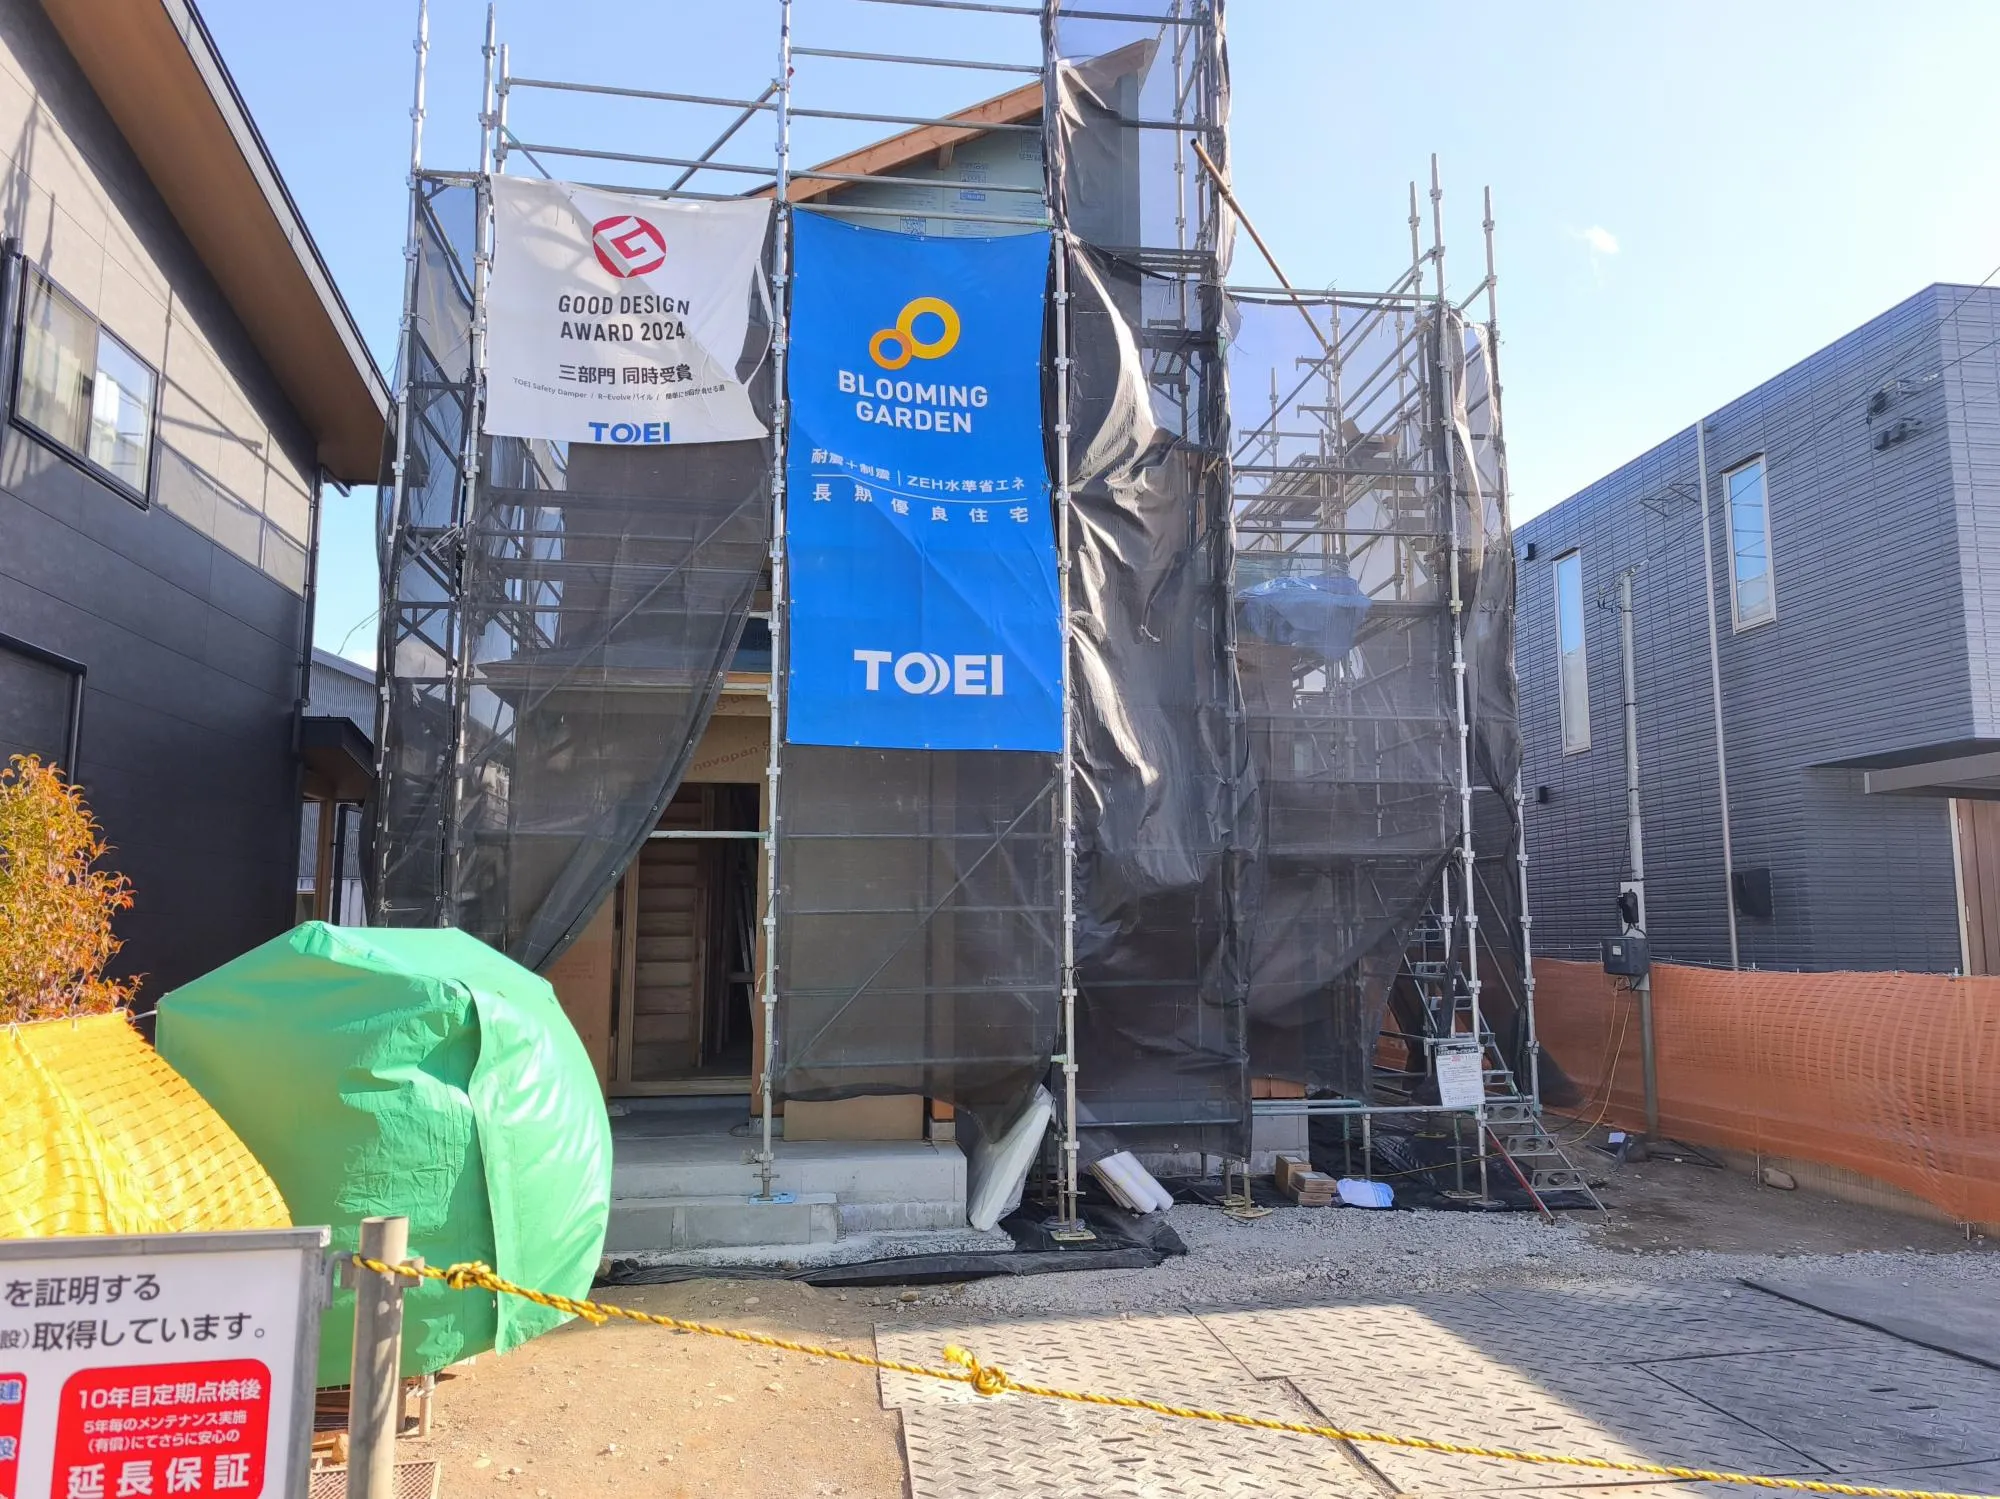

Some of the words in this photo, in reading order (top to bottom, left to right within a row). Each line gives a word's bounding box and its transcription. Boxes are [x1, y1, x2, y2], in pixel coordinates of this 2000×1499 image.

[558, 294, 613, 315] GOOD
[620, 294, 690, 316] DESIGN
[560, 321, 634, 342] AWARD
[641, 321, 686, 341] 2024
[513, 377, 531, 388] TOEI
[533, 382, 556, 394] Safety
[557, 388, 587, 399] Damper
[558, 364, 616, 385] 三部門
[622, 363, 693, 385] 同時受賞
[838, 369, 988, 408] BLOOMING
[856, 401, 972, 433] GARDEN
[4, 1274, 161, 1308] を証明する
[78, 1378, 262, 1410] 10年目定期点検後
[83, 1410, 248, 1434] 5年毎のメンテナンス実施
[67, 1453, 251, 1499] 延長保証
